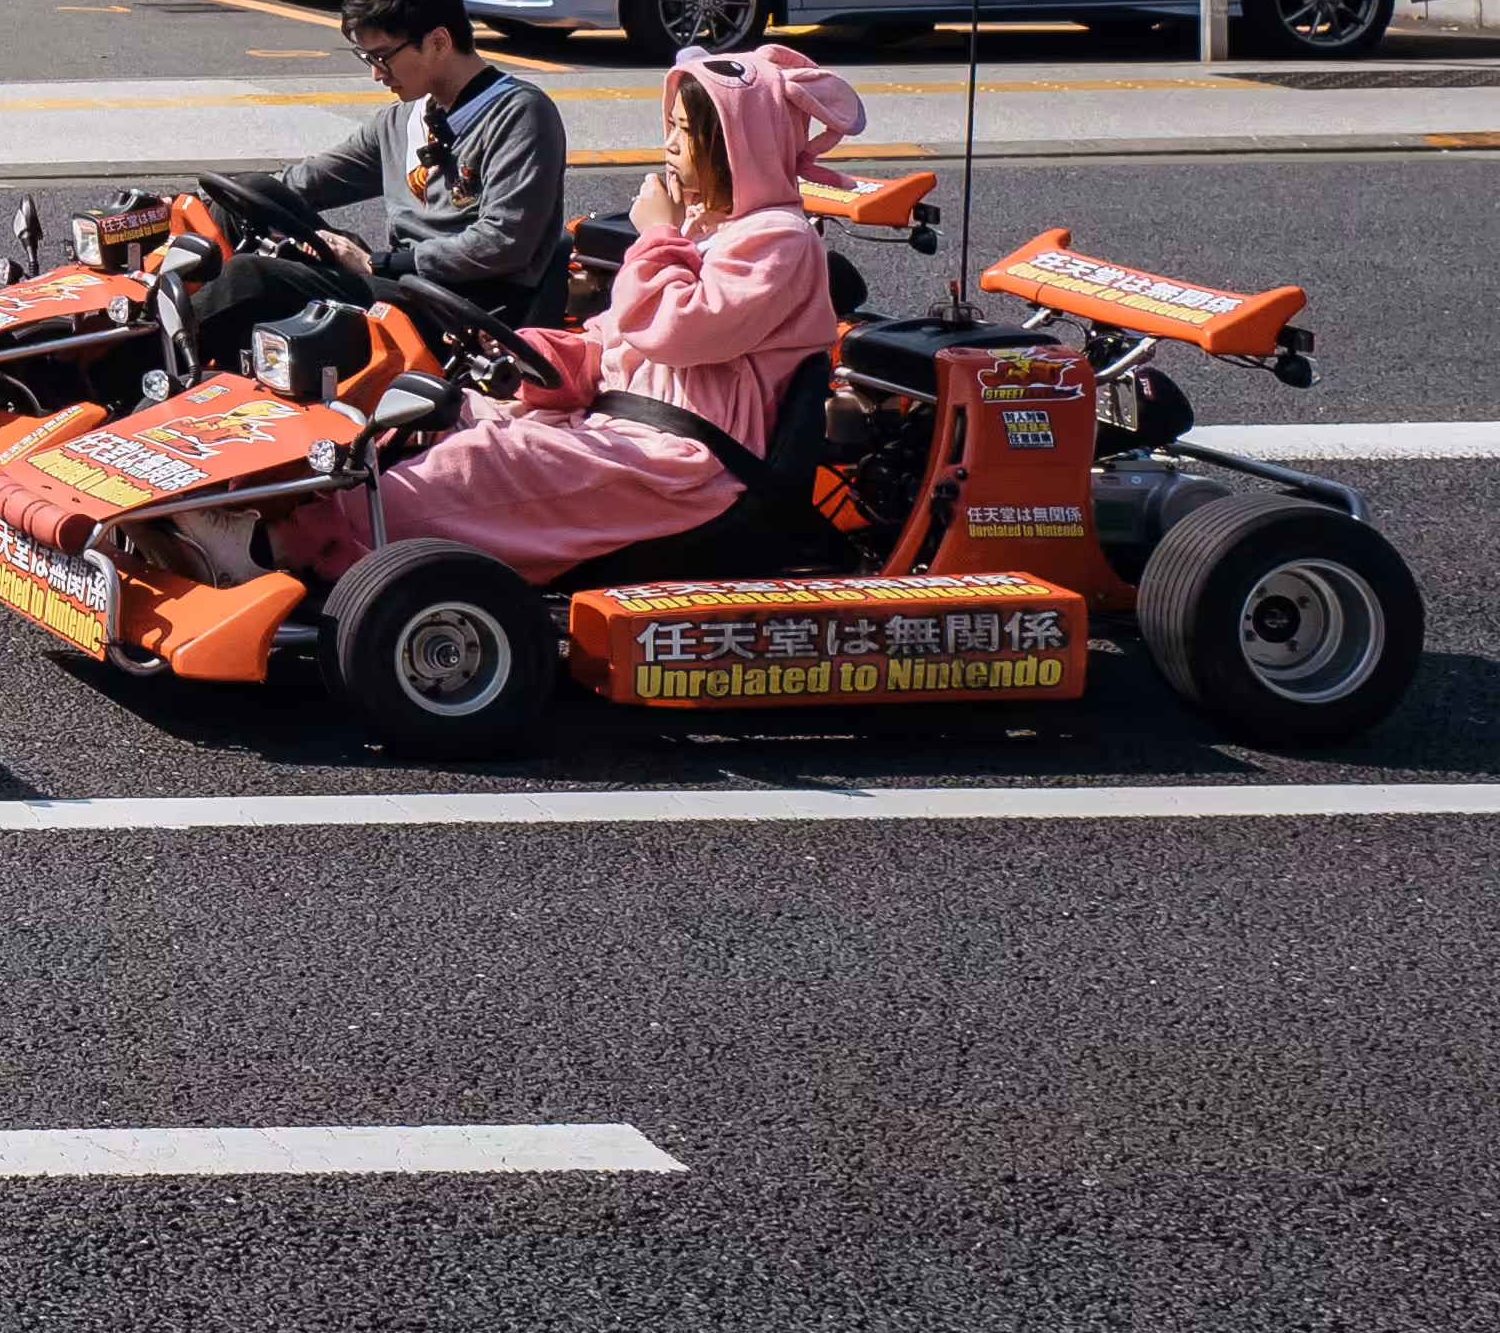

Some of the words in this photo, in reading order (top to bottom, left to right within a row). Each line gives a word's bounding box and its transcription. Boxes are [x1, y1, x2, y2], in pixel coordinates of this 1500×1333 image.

[985, 388, 1025, 400] STREET
[967, 506, 1083, 523] 任天堂は無関係
[636, 609, 1064, 662] 任天堂は無関係
[636, 659, 830, 698] Unrelated
[840, 661, 878, 694] to
[887, 654, 1062, 691] Nintendo
